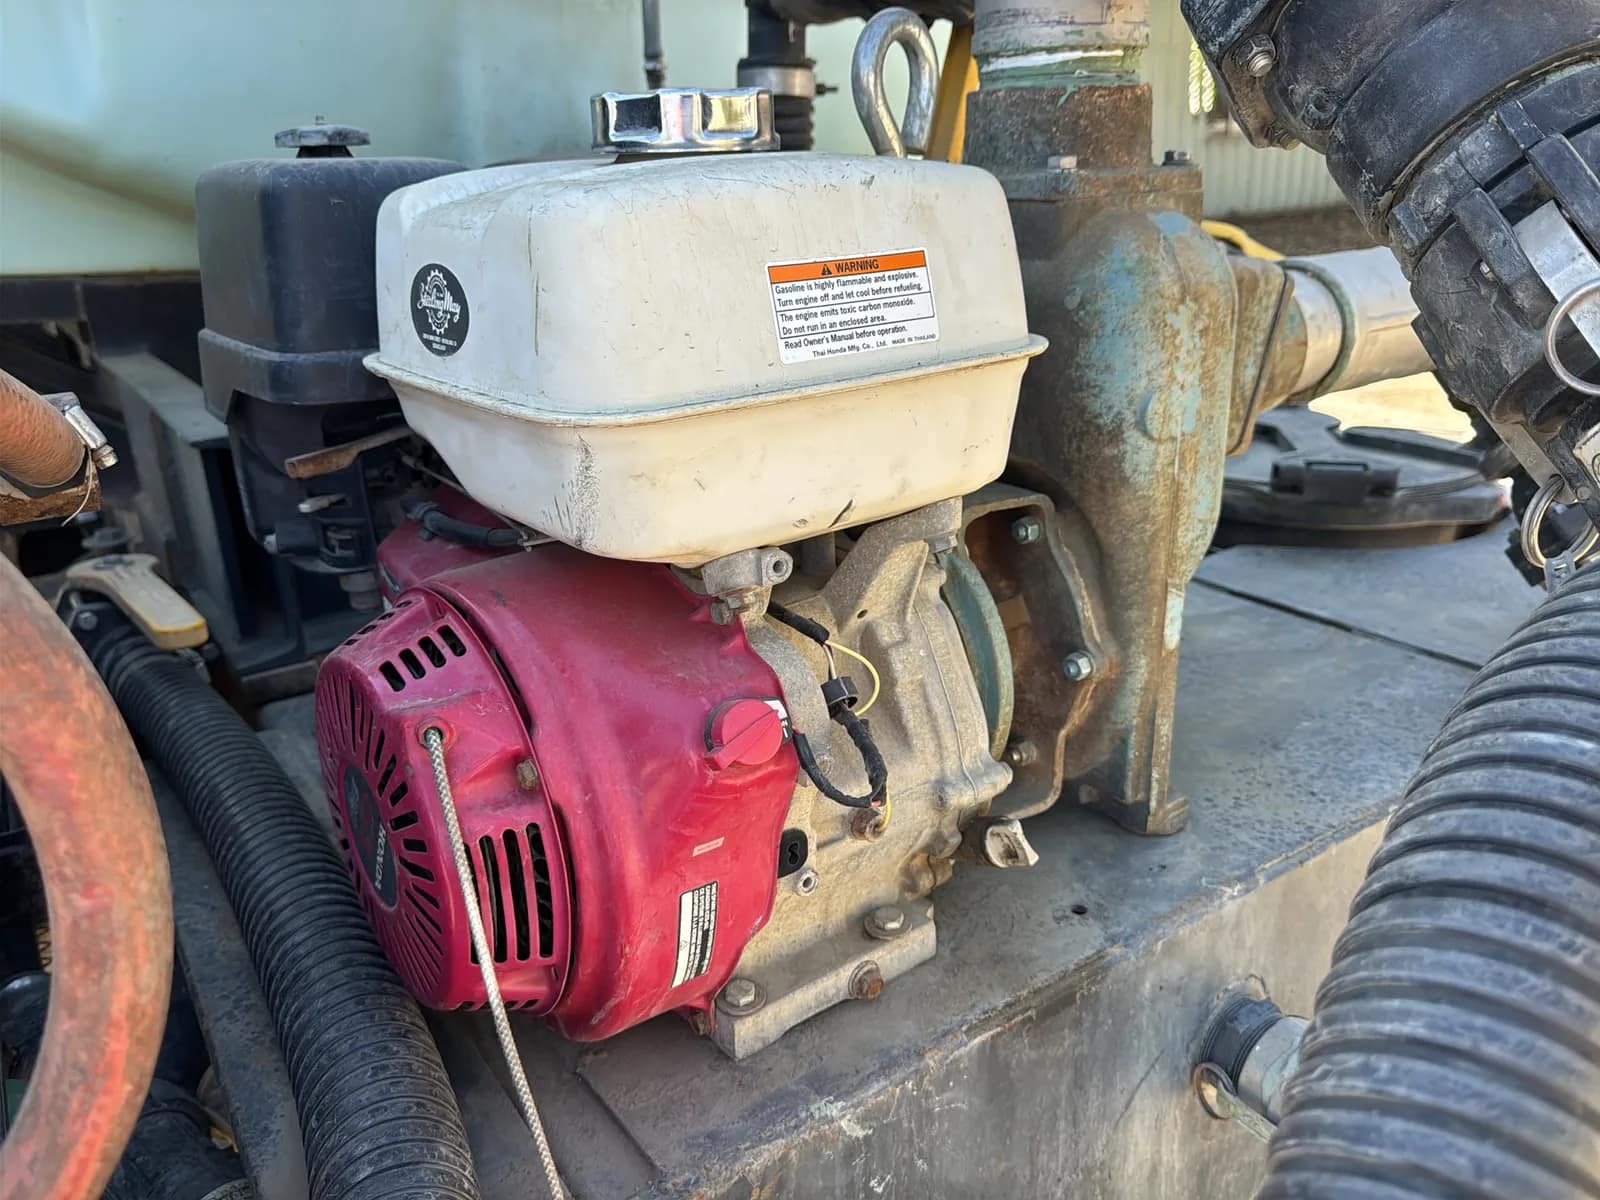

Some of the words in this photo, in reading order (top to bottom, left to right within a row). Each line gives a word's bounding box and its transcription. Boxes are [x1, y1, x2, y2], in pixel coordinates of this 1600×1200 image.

[835, 259, 879, 273] WARNING
[775, 284, 805, 294] Gasoline
[807, 282, 812, 290] is
[814, 280, 834, 291] highly
[837, 276, 872, 287] flammable
[874, 274, 885, 282] and
[888, 271, 919, 282] explosive.
[777, 298, 793, 307] Turn
[795, 295, 818, 305] engine
[820, 293, 829, 302] off
[832, 291, 843, 300] and
[845, 290, 854, 298] let
[856, 288, 870, 297] cool
[871, 286, 892, 295] before
[894, 283, 923, 292] refueling.
[780, 314, 793, 322] The
[796, 311, 818, 321] engine
[820, 308, 838, 317] emits
[840, 305, 856, 314] toxic
[858, 302, 881, 312] carbon
[883, 298, 916, 308] monoxide.
[782, 327, 792, 335] Do
[794, 325, 805, 333] not
[807, 324, 818, 332] run
[839, 316, 868, 327] enclosed
[785, 340, 802, 349] Read
[804, 336, 829, 346] Owner's
[831, 332, 854, 342] Manual
[855, 330, 875, 339] before
[877, 325, 907, 336] operation.
[827, 347, 846, 355] Honda
